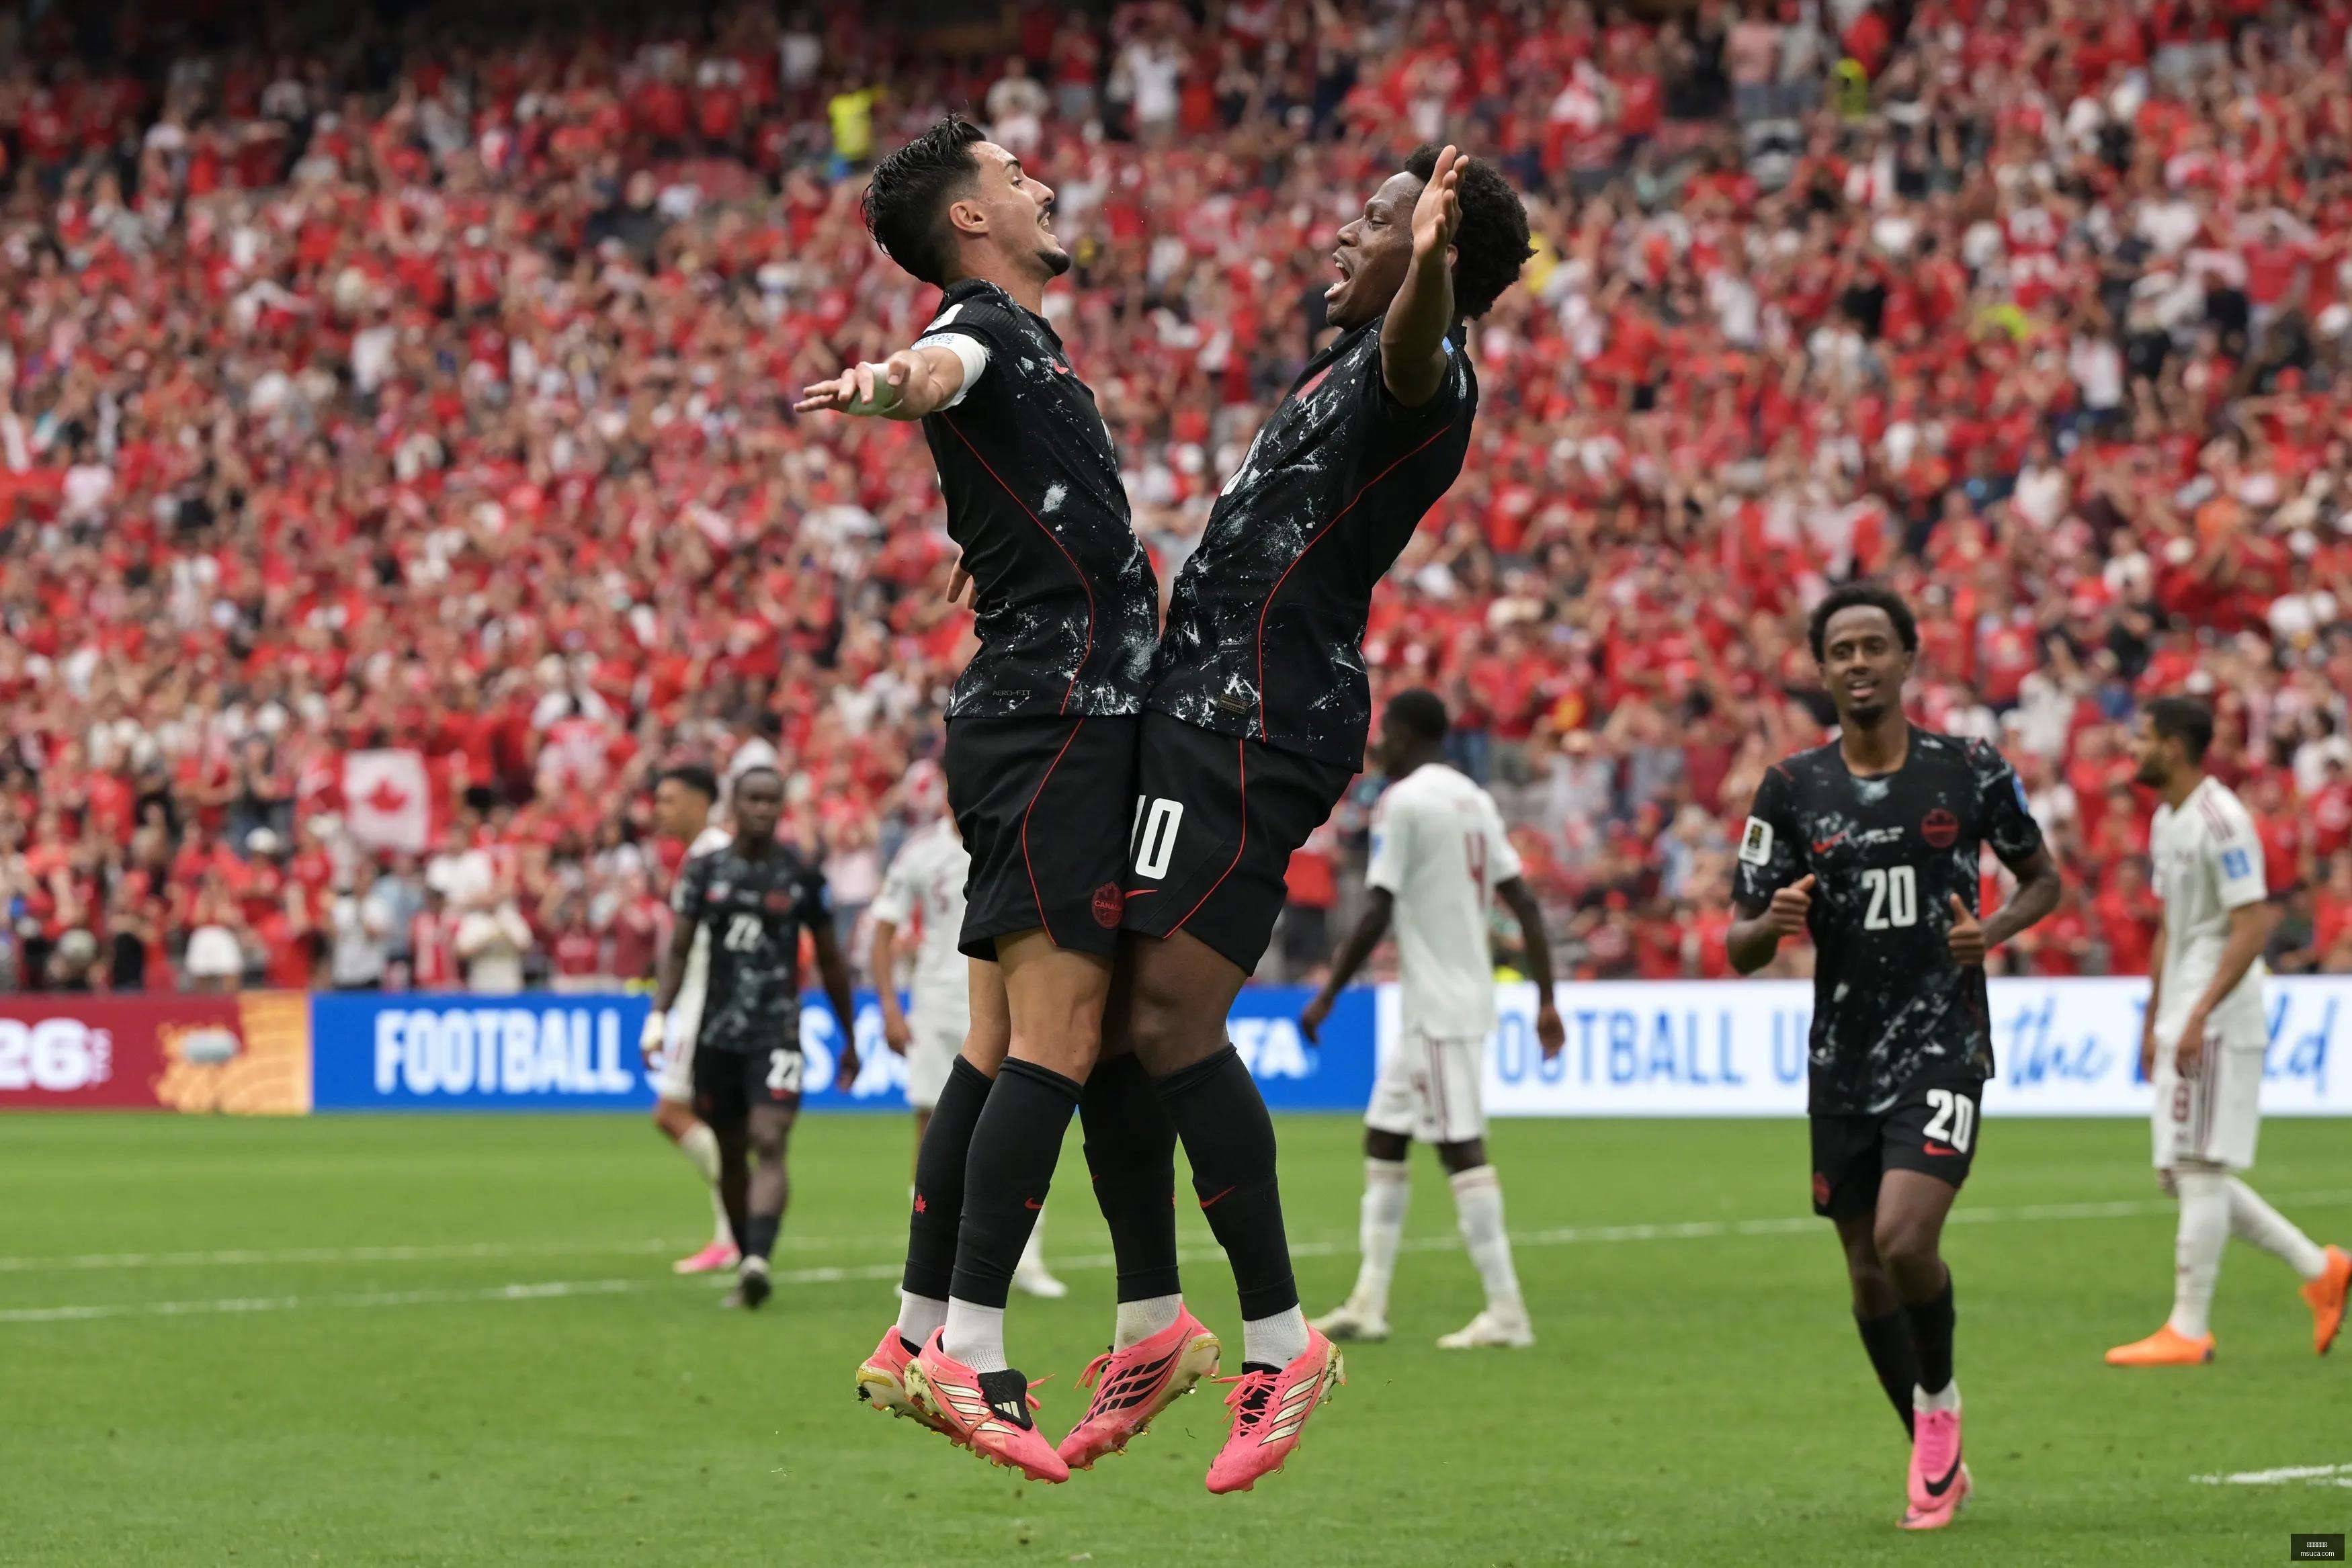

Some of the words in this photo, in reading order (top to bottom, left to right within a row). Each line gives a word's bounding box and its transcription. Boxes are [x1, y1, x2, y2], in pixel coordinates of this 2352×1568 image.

[1861, 866, 1918, 931] 20
[374, 1008, 635, 1094] FOOTBALL
[1497, 1010, 1746, 1084] OTBALL
[1923, 1088, 1974, 1154] 20
